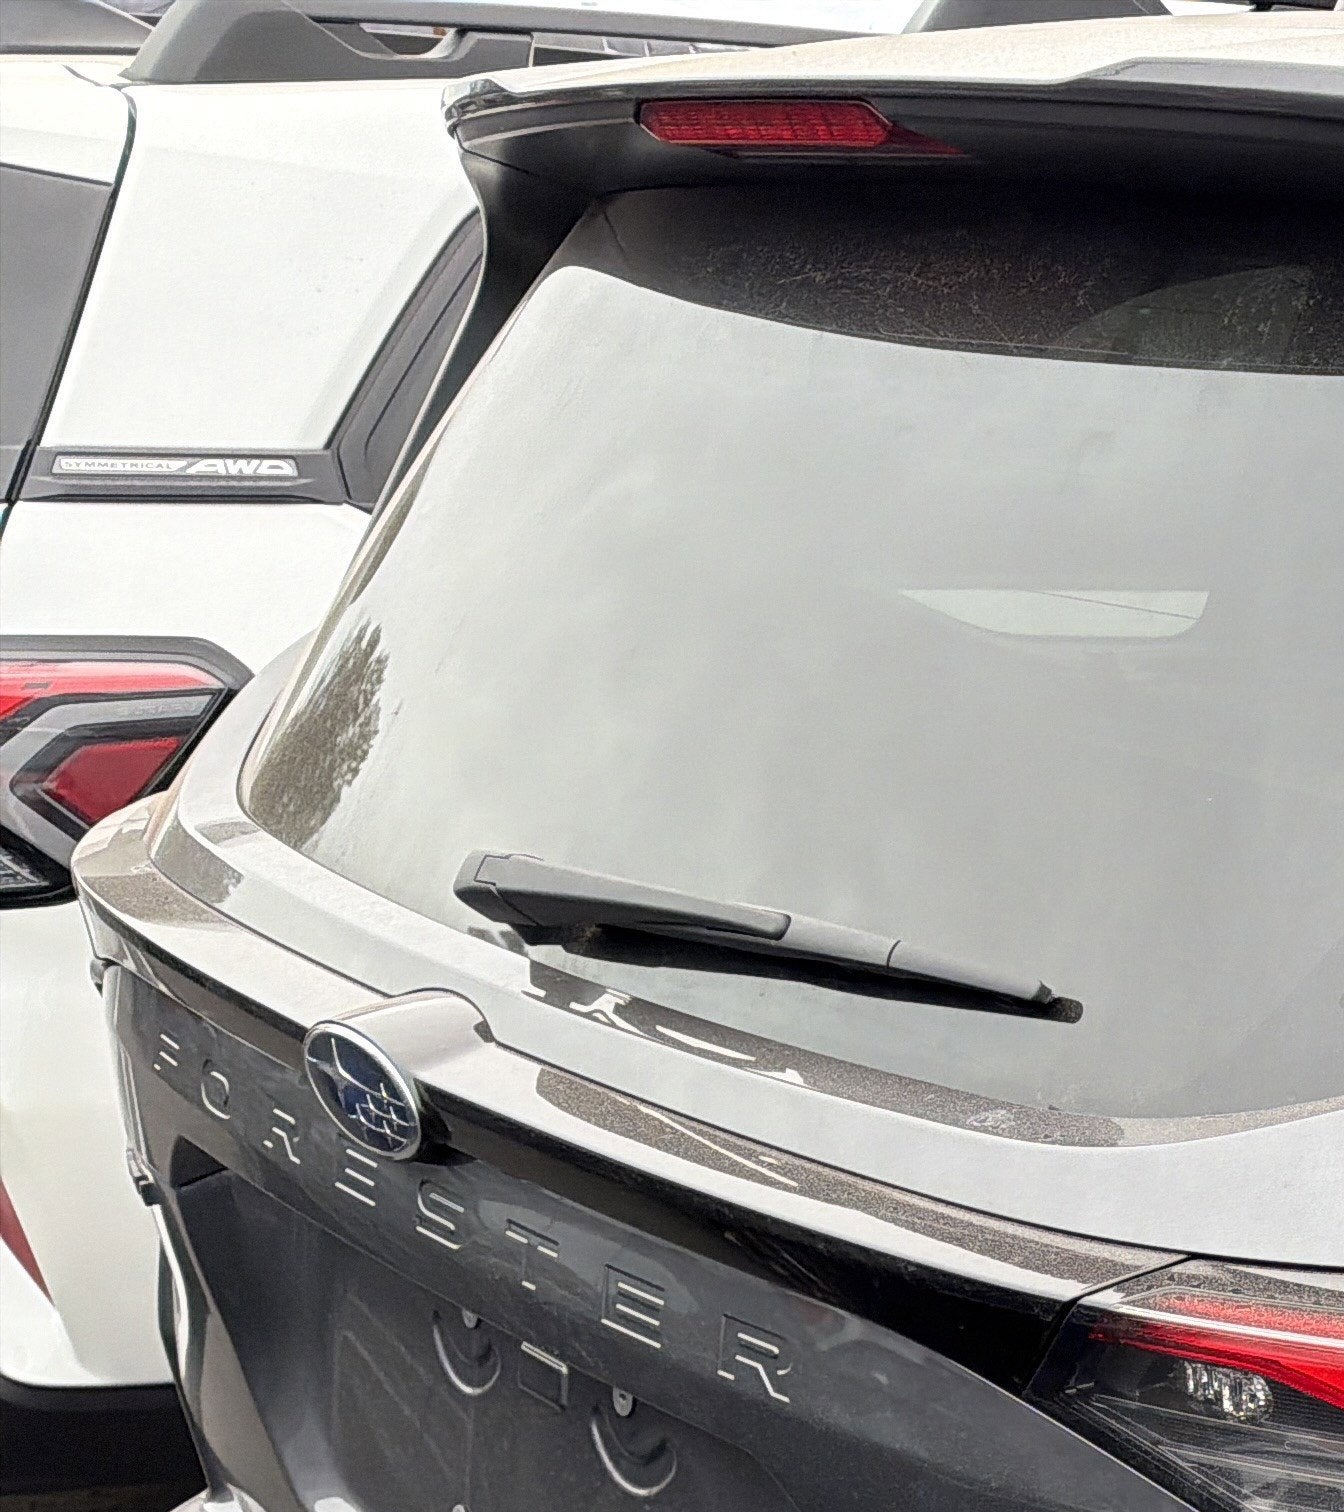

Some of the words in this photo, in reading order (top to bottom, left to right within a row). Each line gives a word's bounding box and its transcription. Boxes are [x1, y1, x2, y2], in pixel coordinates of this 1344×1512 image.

[64, 460, 173, 471] SYMMETRICAL
[186, 458, 294, 475] AWD
[153, 1031, 793, 1403] FORESTER
